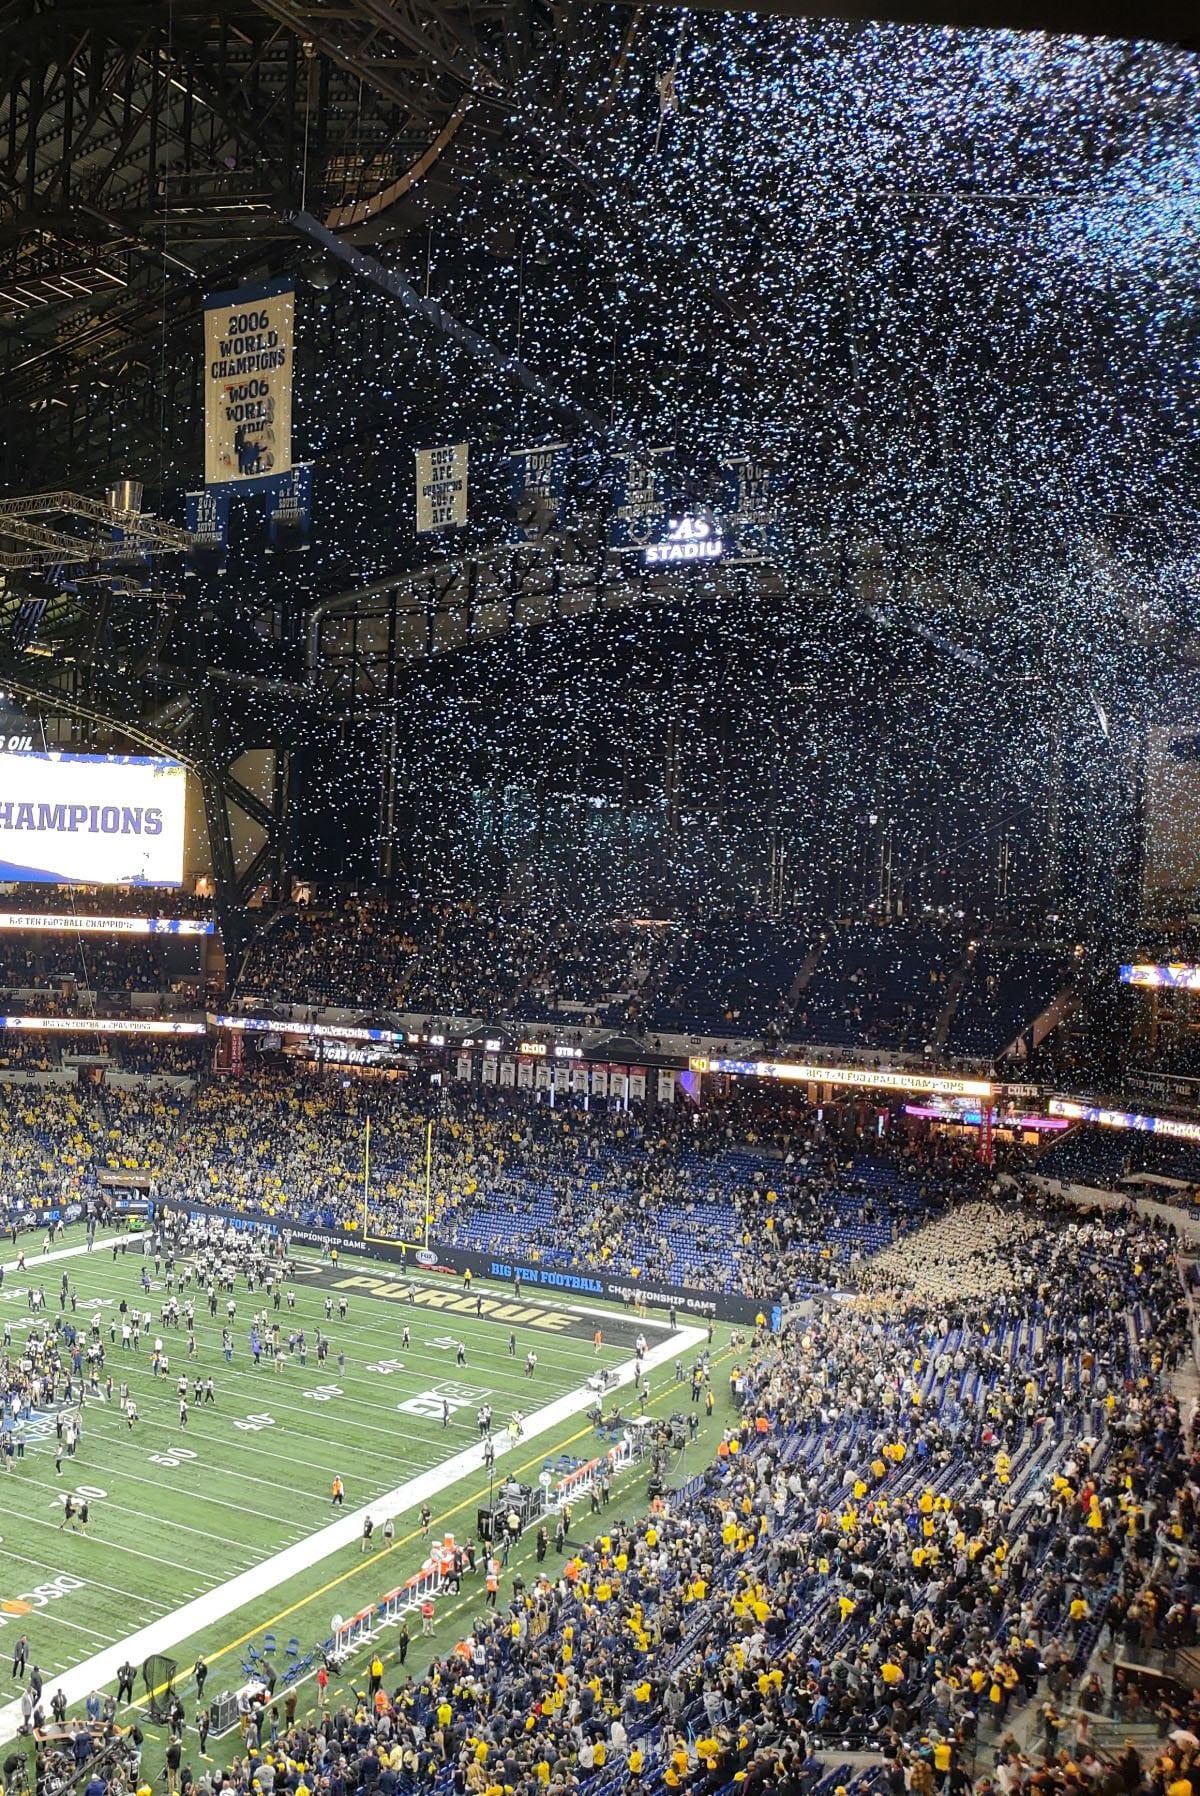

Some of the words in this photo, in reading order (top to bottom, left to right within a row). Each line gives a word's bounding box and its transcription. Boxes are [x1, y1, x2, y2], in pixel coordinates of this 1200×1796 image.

[228, 310, 269, 336] 2006
[219, 330, 278, 358] WORLD
[211, 349, 285, 379] CHAMPIONS
[7, 735, 33, 751] OIL
[430, 1034, 445, 1046] 43
[520, 1041, 546, 1055] 0:00
[1008, 1085, 1038, 1097] COLTS
[343, 1238, 367, 1250] GAME
[491, 1262, 512, 1279] BIG
[515, 1266, 539, 1283] TEN
[540, 1270, 604, 1293] FOOTBALL
[608, 1284, 685, 1305] CHAMPIONSHIP
[687, 1297, 717, 1310] GAME
[330, 1275, 584, 1331] PURDUE
[232, 1412, 277, 1432] 40
[147, 1447, 198, 1468] 50
